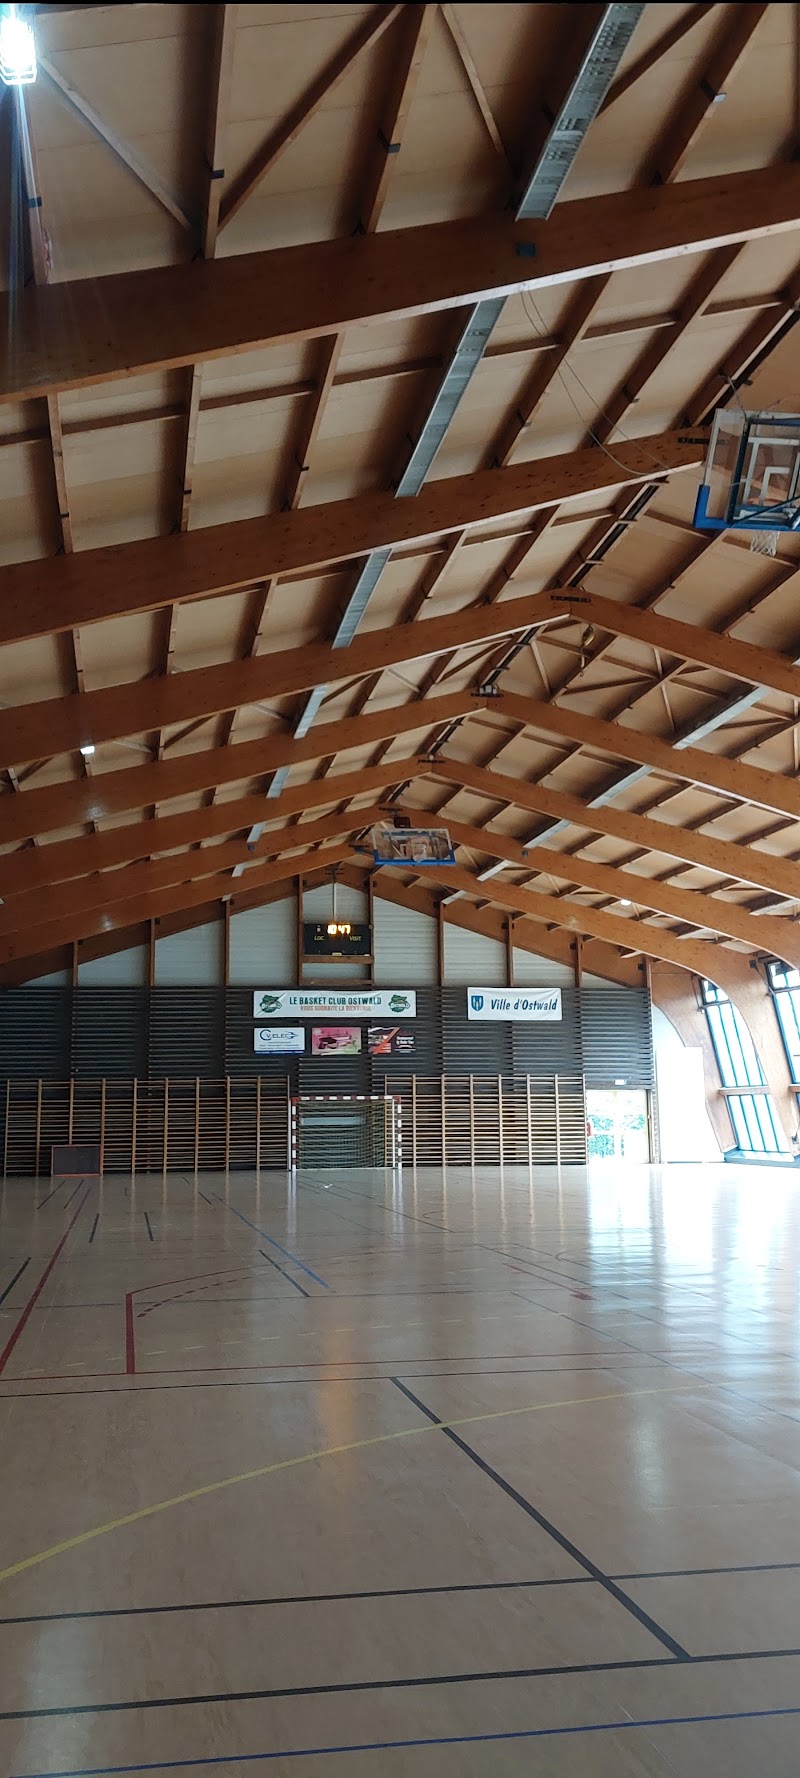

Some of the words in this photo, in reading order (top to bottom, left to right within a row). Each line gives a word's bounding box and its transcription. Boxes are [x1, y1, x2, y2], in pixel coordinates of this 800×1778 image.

[289, 997, 297, 1005] LE
[299, 997, 326, 1005] BASKET
[328, 997, 346, 1005] CLUB
[348, 997, 382, 1005] OSTWALD
[491, 999, 511, 1011] Ville
[513, 999, 558, 1011] d'Ostwald
